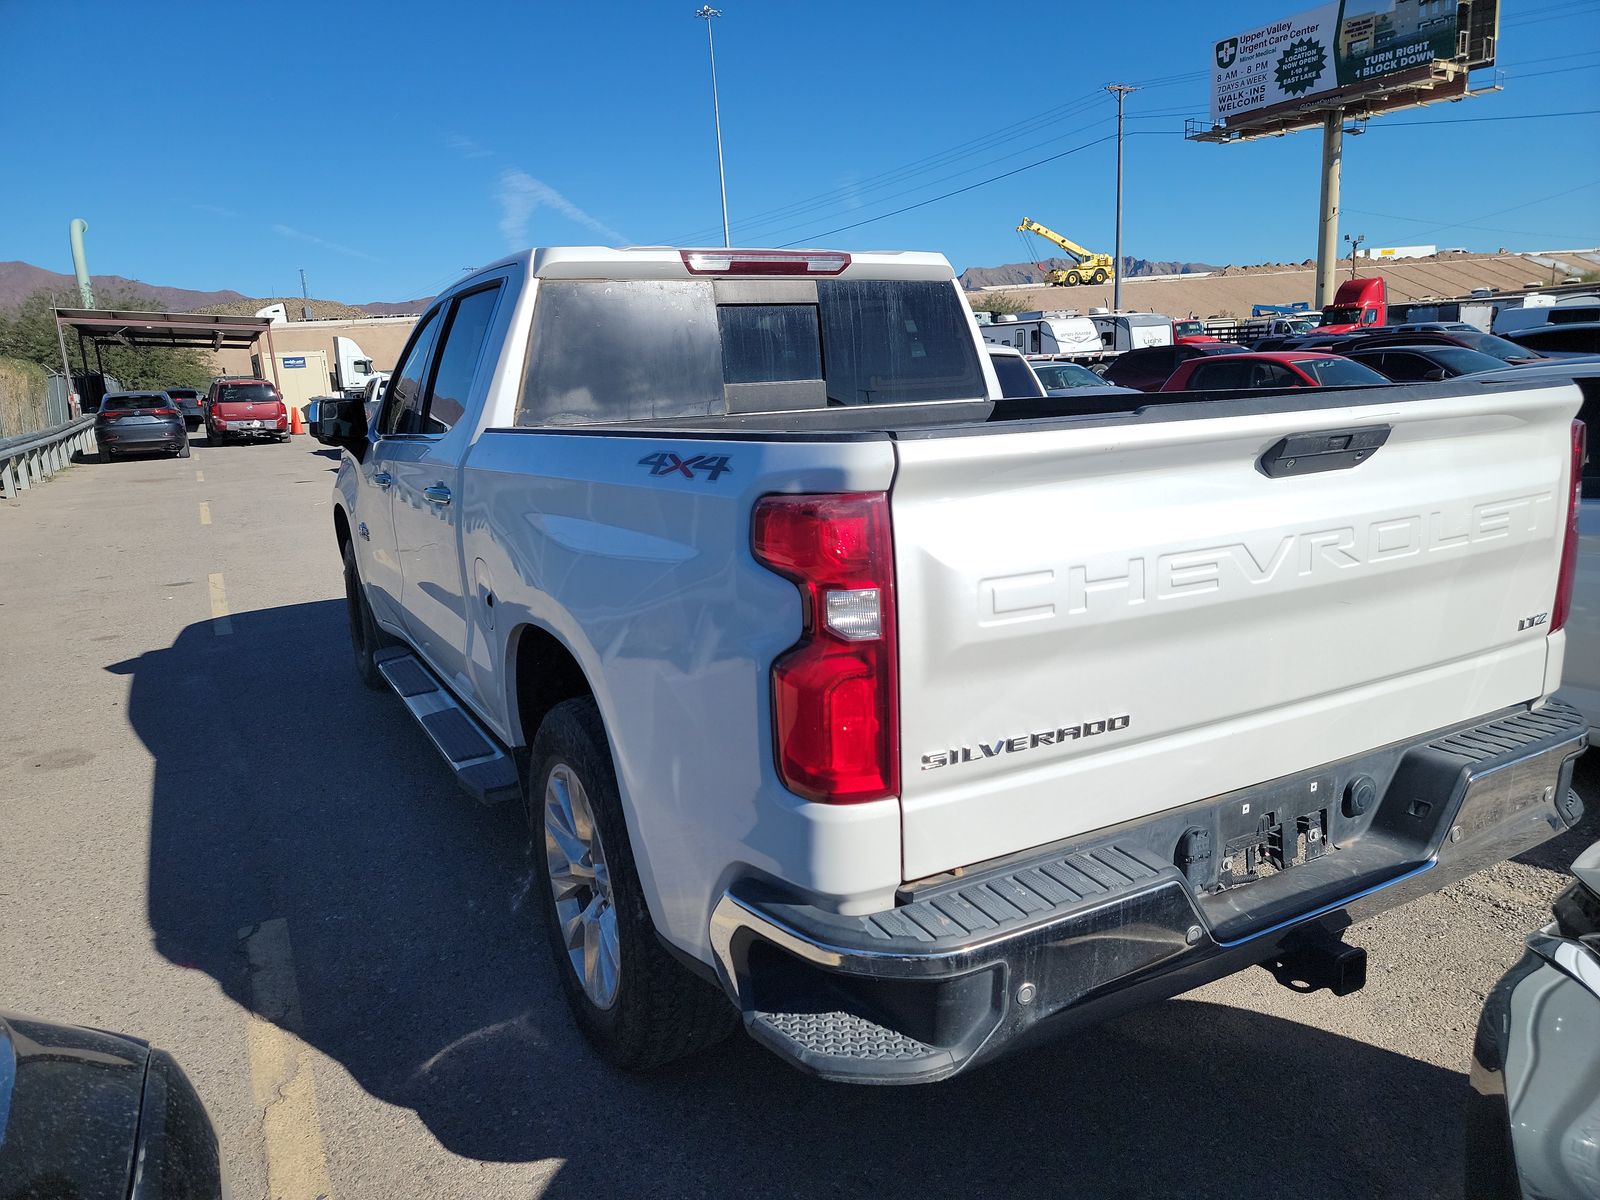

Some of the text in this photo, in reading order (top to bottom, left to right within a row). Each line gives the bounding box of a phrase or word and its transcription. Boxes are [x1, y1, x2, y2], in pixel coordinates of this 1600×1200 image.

[1240, 22, 1292, 44] Upper Valley
[1240, 24, 1320, 54] Urgent Care Center
[1240, 47, 1277, 62] Minor Medical
[1282, 55, 1319, 70] NOW OPEN!
[1285, 49, 1317, 63] LOCATION
[1365, 41, 1430, 66] TURN RIGHT
[1216, 74, 1222, 83] 8
[1225, 70, 1238, 80] AM
[1246, 65, 1252, 74] 8
[1255, 60, 1268, 71] PM
[1355, 50, 1435, 78] 1 BLOCK DOWN
[1246, 73, 1268, 85] WEEK
[1283, 70, 1317, 85] EAST LAKE
[1218, 94, 1265, 112] WELCOME
[978, 490, 1552, 628] CHEVROLET
[1517, 612, 1548, 631] LTZ
[920, 714, 1131, 771] SILVERADO
